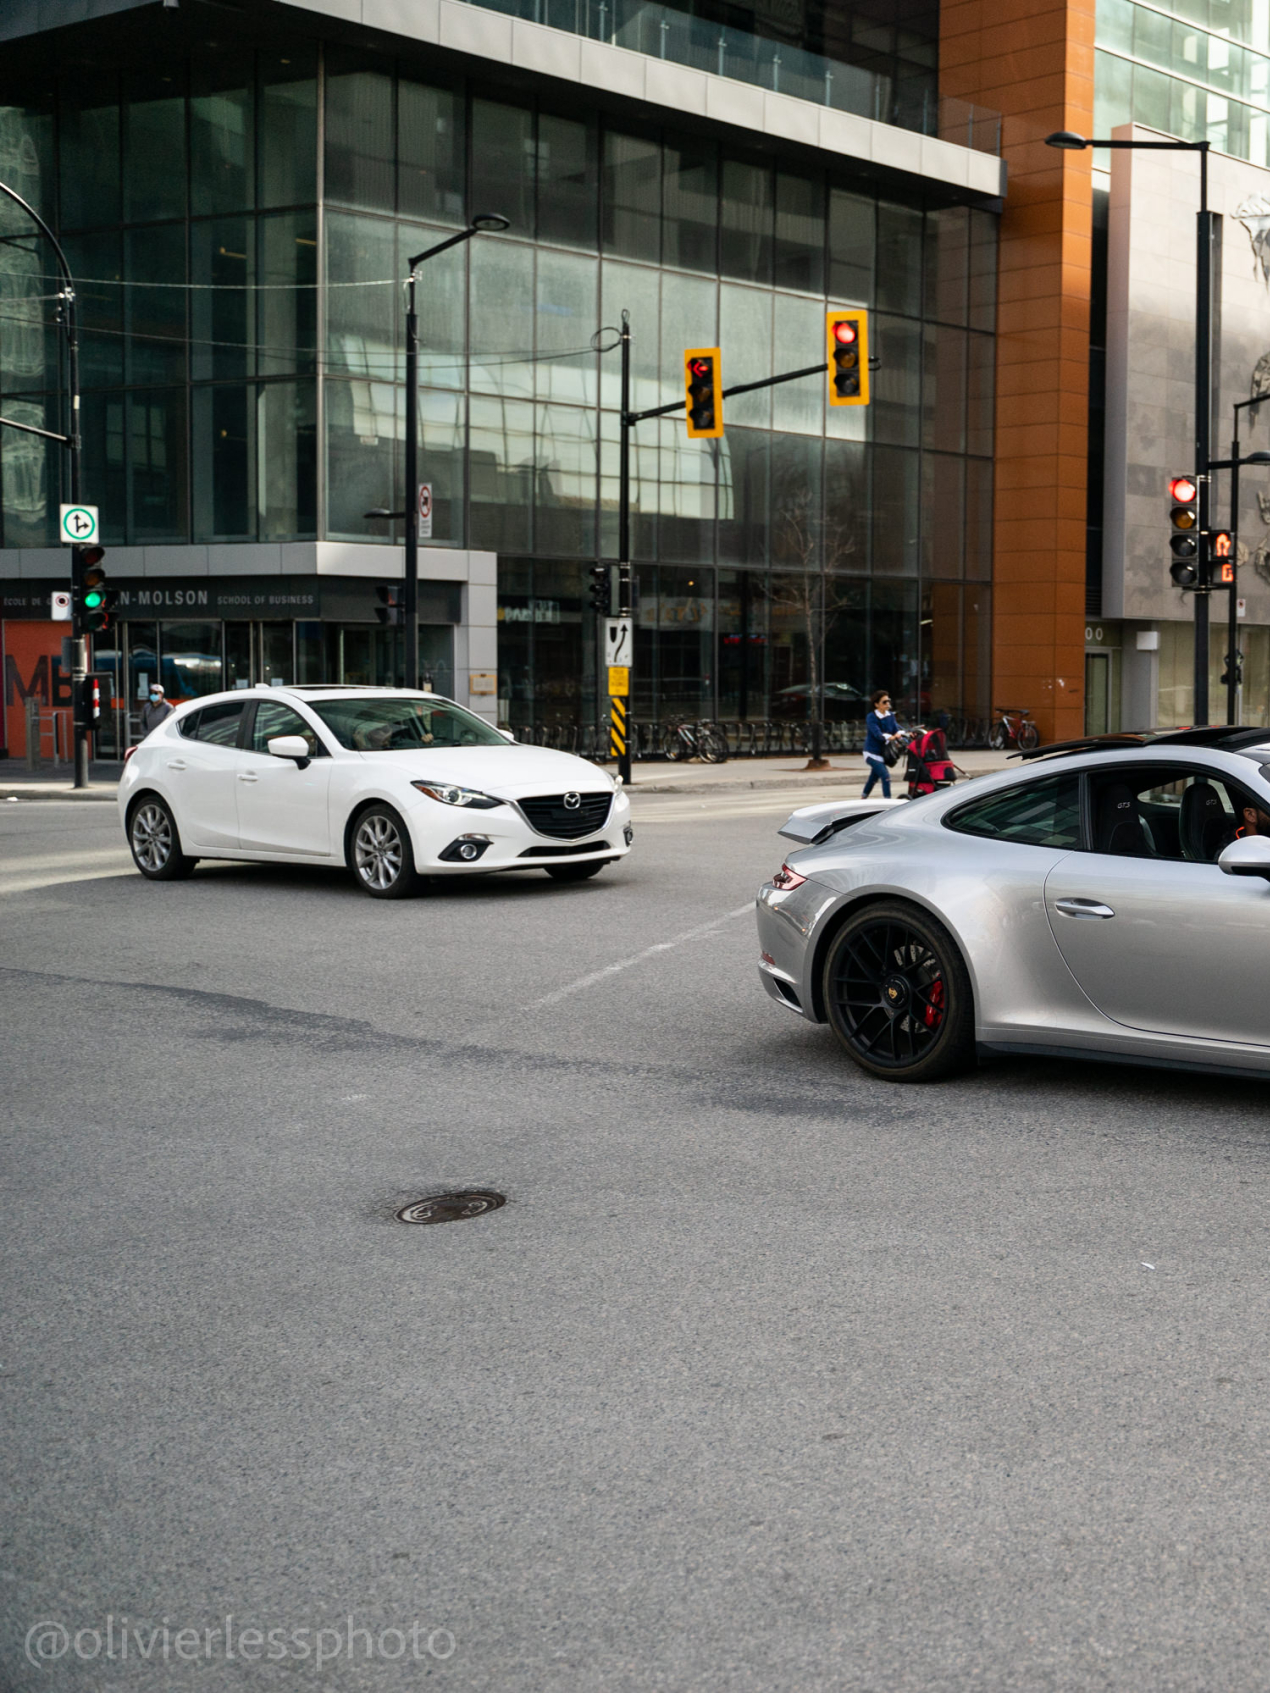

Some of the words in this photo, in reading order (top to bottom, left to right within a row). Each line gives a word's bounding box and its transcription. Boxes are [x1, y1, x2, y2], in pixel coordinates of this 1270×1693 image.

[32, 597, 41, 606] DE
[119, 590, 208, 606] N-MOLSON
[217, 595, 252, 606] SCHOOL
[254, 595, 267, 605] OF
[268, 594, 314, 606] BUSINESS
